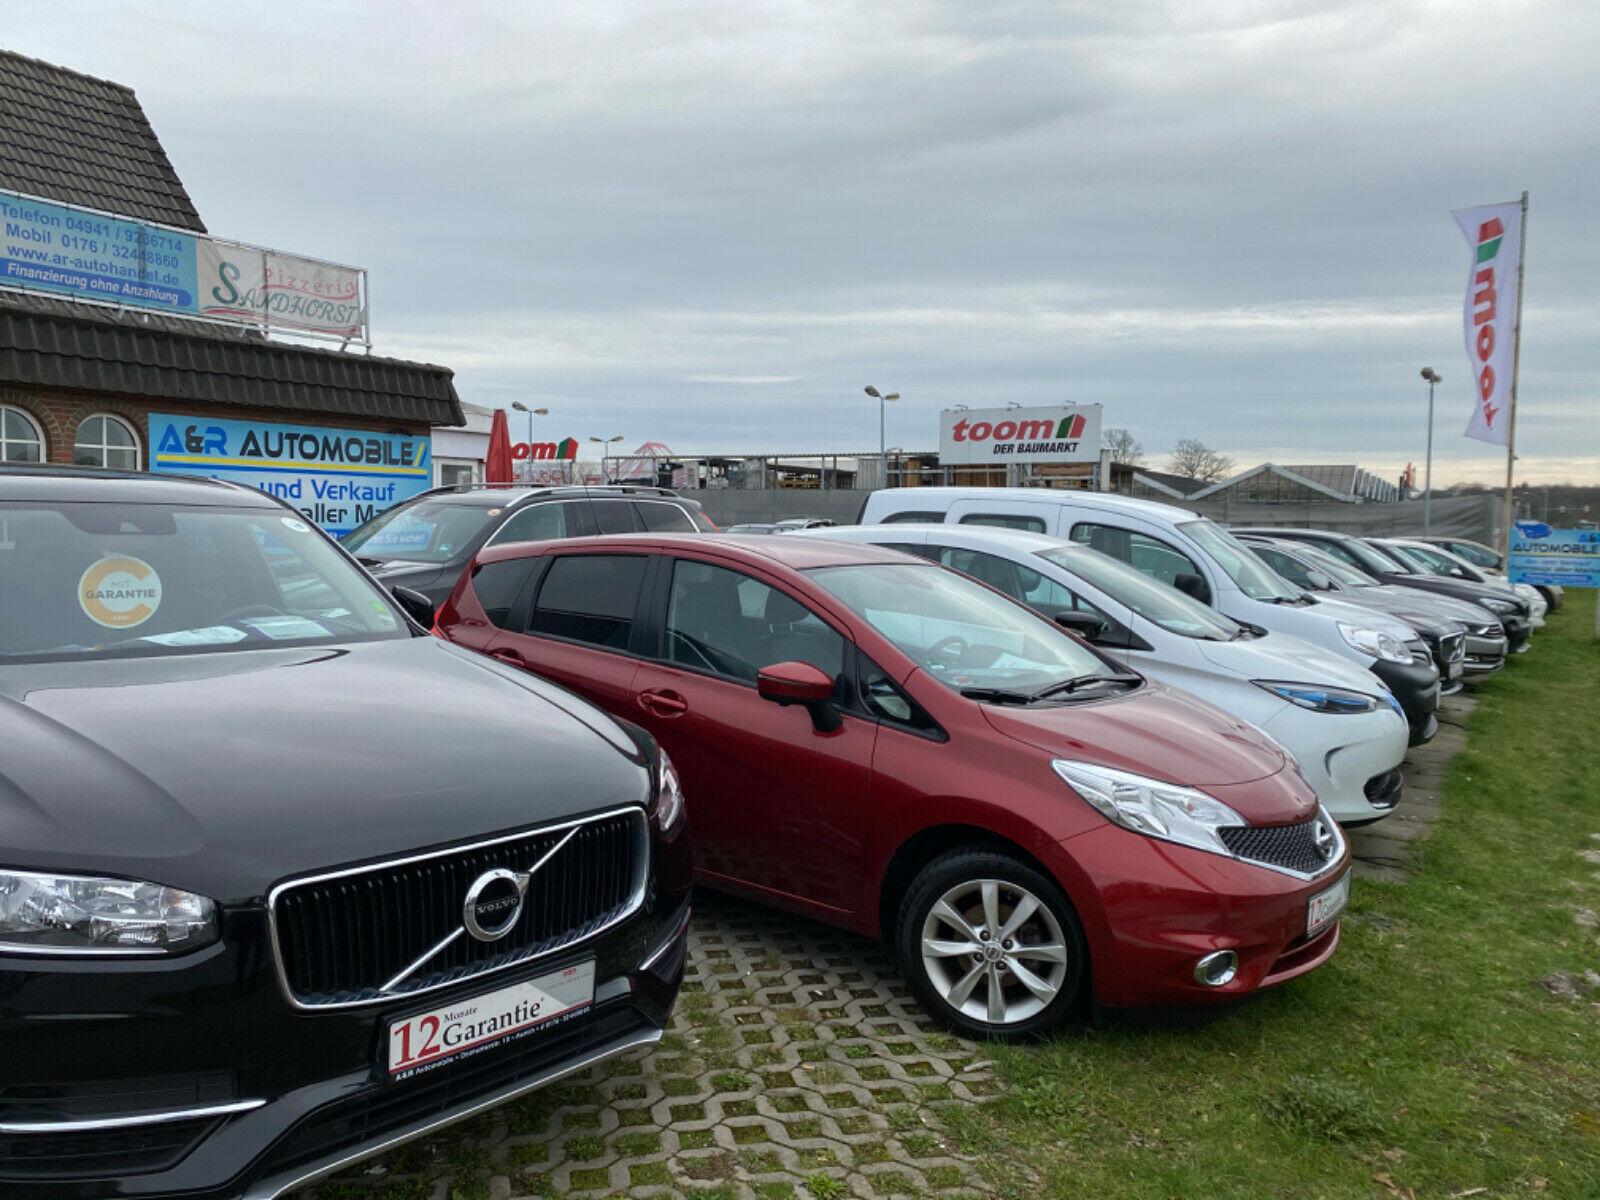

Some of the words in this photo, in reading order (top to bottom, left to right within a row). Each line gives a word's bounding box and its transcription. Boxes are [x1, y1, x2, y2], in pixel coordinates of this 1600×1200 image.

[0, 202, 60, 227] Telefon
[66, 217, 109, 237] 04941
[5, 222, 51, 244] Mobil
[61, 234, 98, 253] 0176
[7, 245, 180, 286] www.ar-autohandel.de
[7, 262, 87, 290] Finanzierung
[90, 279, 119, 293] ohne
[122, 283, 179, 305] Anzahlung
[212, 261, 360, 324] SANDHORST
[1474, 267, 1499, 431] toom
[157, 424, 228, 455] A&R
[952, 417, 1055, 442] toom
[993, 443, 1015, 455] DER
[1017, 442, 1080, 454] BAUMARKT
[310, 479, 395, 501] Verkauf
[300, 503, 348, 523] aller
[85, 588, 157, 600] GARANTIE
[478, 897, 518, 914] VOLVO
[442, 1000, 541, 1047] Garantie
[443, 1006, 479, 1024] Monate
[393, 1015, 441, 1066] 12
